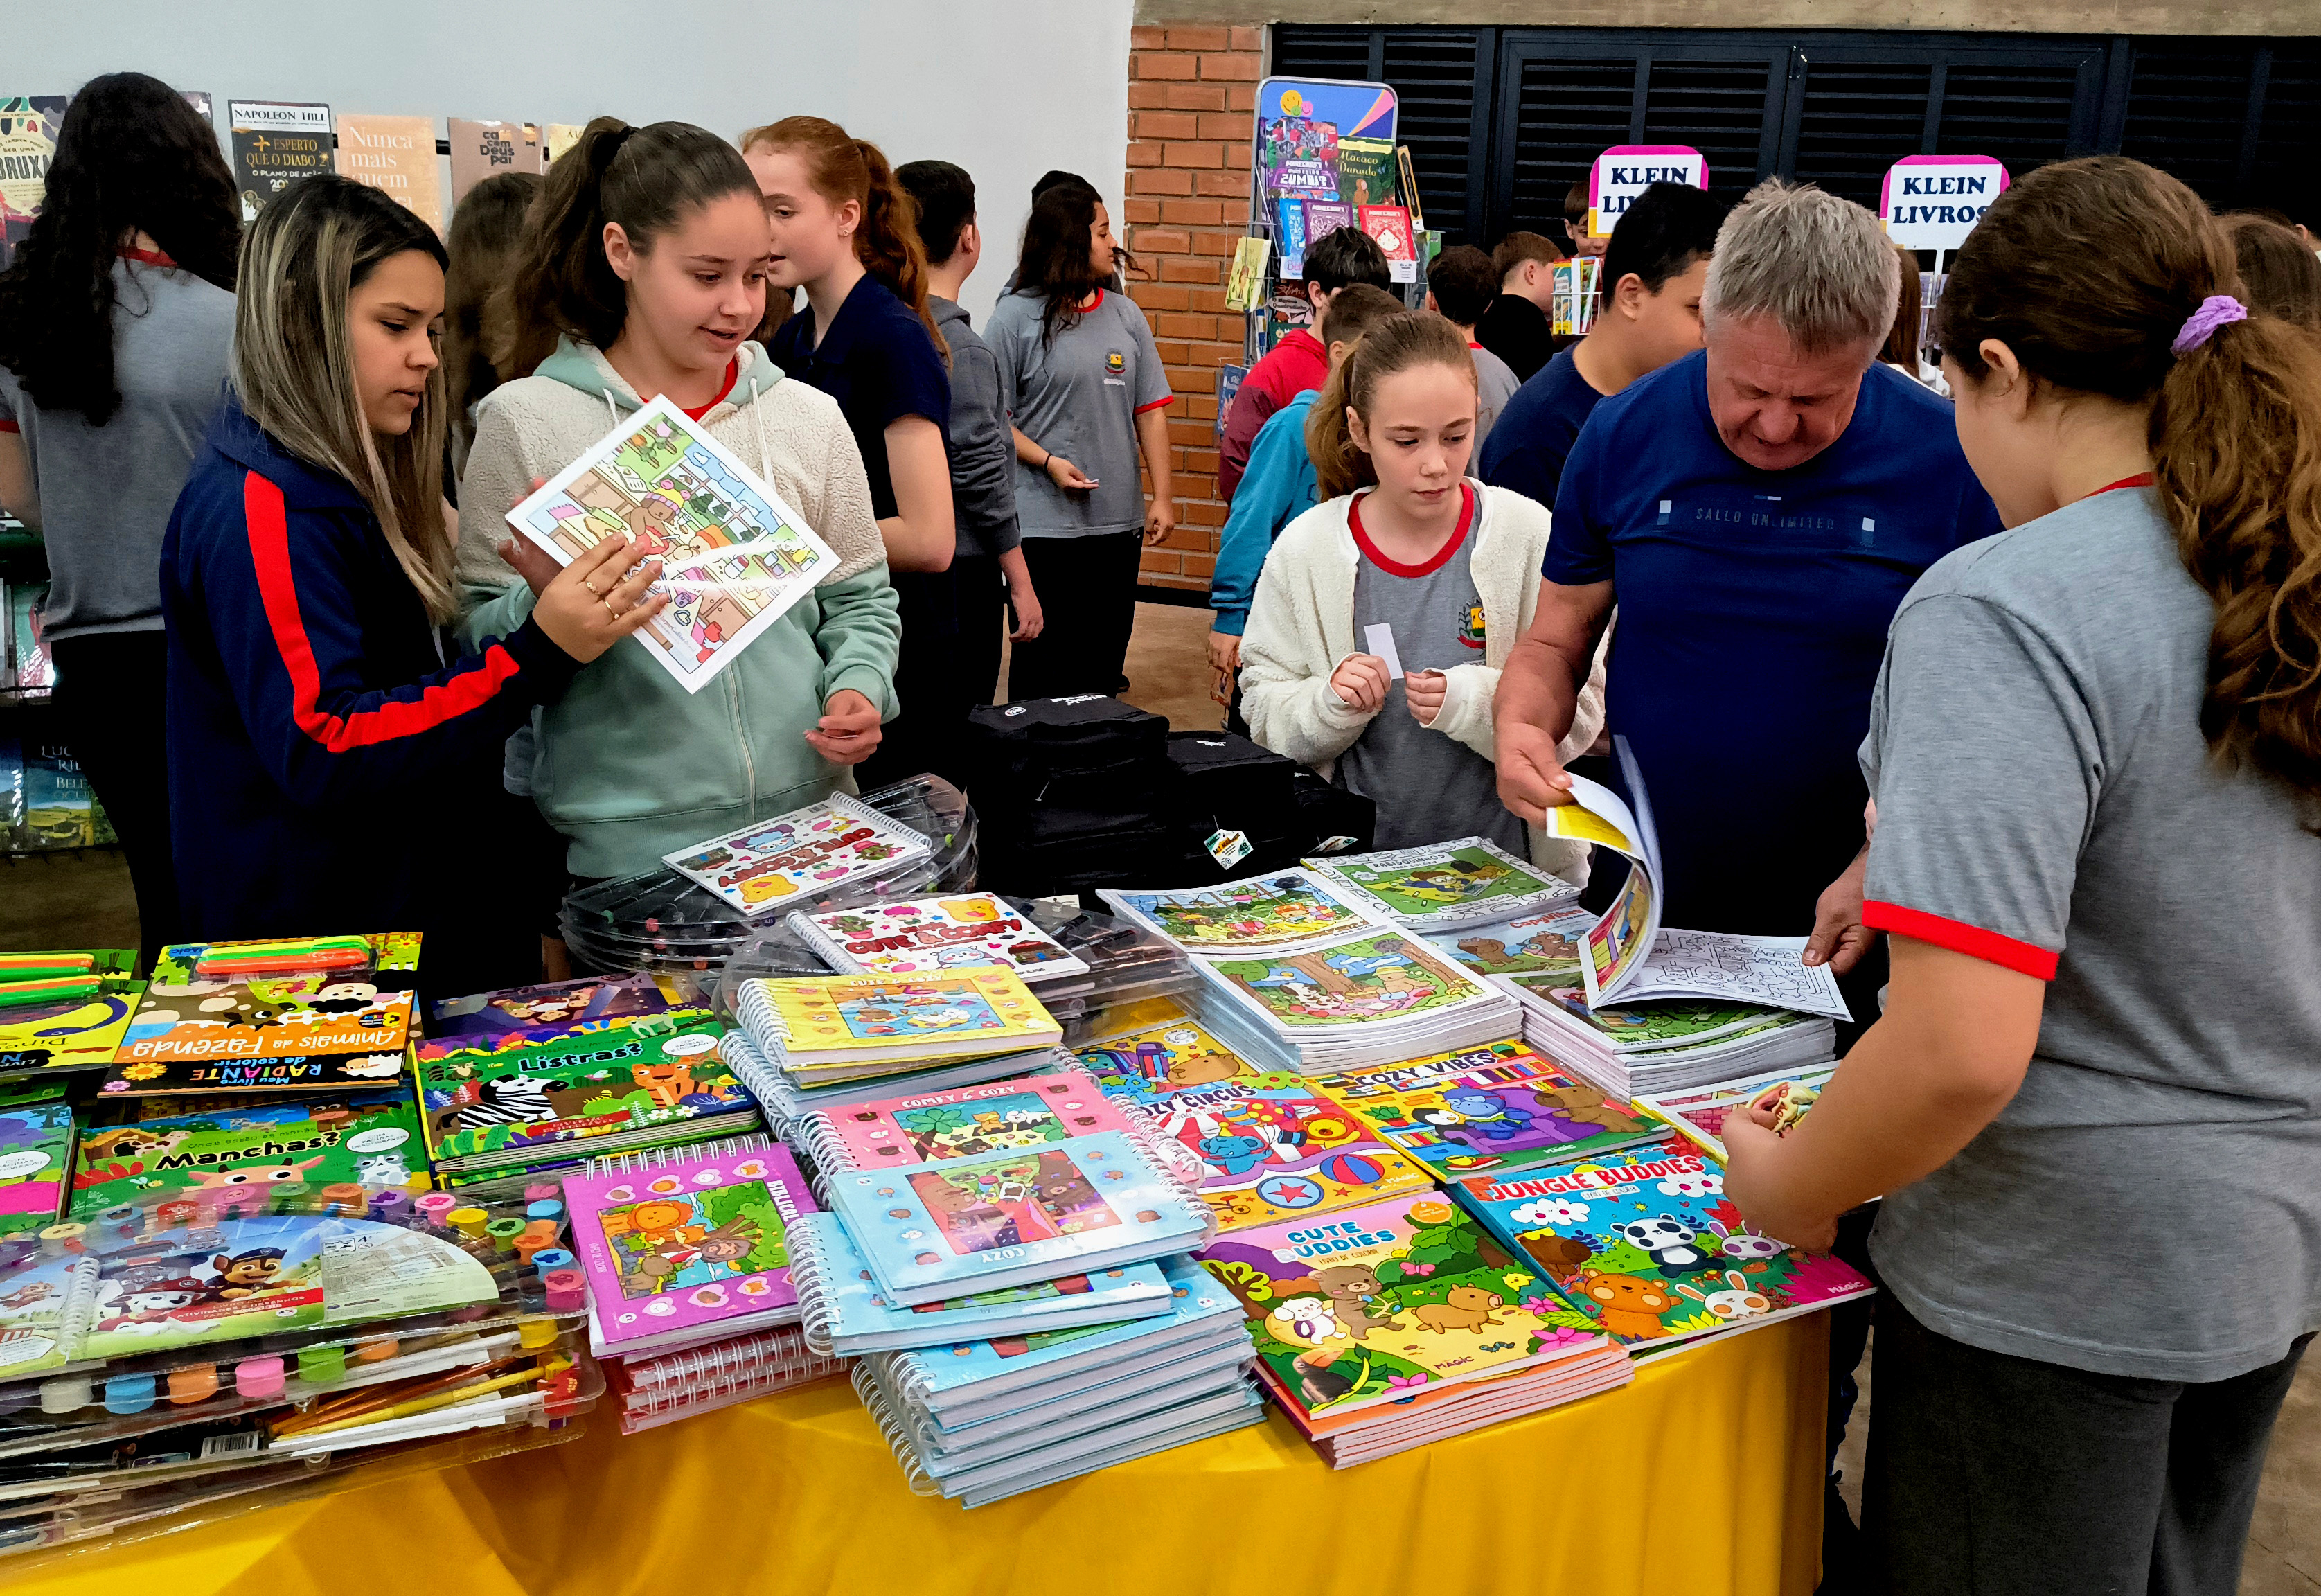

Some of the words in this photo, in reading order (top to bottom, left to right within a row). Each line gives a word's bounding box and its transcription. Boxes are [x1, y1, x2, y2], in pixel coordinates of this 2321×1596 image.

[235, 109, 296, 121] NAPOLEON
[302, 112, 327, 122] HILL
[274, 139, 317, 152] ESPERTO
[350, 126, 413, 149] Nunca
[479, 144, 515, 156] Deus
[1341, 150, 1379, 165] Macaco
[246, 152, 269, 168] QUE
[272, 154, 281, 166] O
[283, 154, 316, 167] DIABO
[351, 152, 397, 168] mais
[490, 154, 513, 166] pai
[1340, 161, 1377, 177] Danado
[1611, 167, 1689, 185] KLEIN
[1903, 177, 1986, 195] KLEIN
[1696, 508, 1741, 523] SALLO
[814, 828, 875, 852] CUTE
[1509, 909, 1584, 928] CapyVibes
[844, 935, 916, 954] CUTE
[939, 919, 1022, 939] COMFY
[383, 1011, 401, 1027] 3
[132, 1036, 263, 1057] Fazenda
[273, 1039, 292, 1049] da
[299, 1030, 397, 1047] Animais
[214, 1057, 278, 1068] colorir
[284, 1056, 306, 1065] de
[519, 1042, 643, 1072] Listras?
[190, 1063, 321, 1081] RADIANTE
[1355, 1067, 1420, 1086] COZY
[1423, 1053, 1497, 1074] VIBES
[220, 1076, 257, 1085] livro
[259, 1076, 290, 1085] Meu
[902, 1094, 955, 1108] COMFY
[962, 1089, 975, 1099] &
[979, 1085, 1015, 1097] COZY
[1181, 1085, 1256, 1108] CIRCUS
[153, 1131, 341, 1171] Manchas?
[1543, 1145, 1576, 1154] MAGIC
[1385, 1173, 1420, 1183] MAGIC
[1492, 1173, 1594, 1200] JUNGLE
[1594, 1157, 1705, 1185] BUDDIES
[767, 1180, 799, 1223] BIBLICAL
[1288, 1221, 1362, 1243] CUTE
[1274, 1230, 1396, 1263] BUDDIES
[981, 1247, 1026, 1264] COZY
[1319, 1257, 1339, 1265] LIVRO
[1351, 1248, 1378, 1259] COLORIR
[1827, 1281, 1864, 1294] MAGIC
[177, 1305, 239, 1318] ATIVIDADES
[250, 1295, 305, 1307] DESENHOS
[1433, 1356, 1475, 1370] MAGIC
